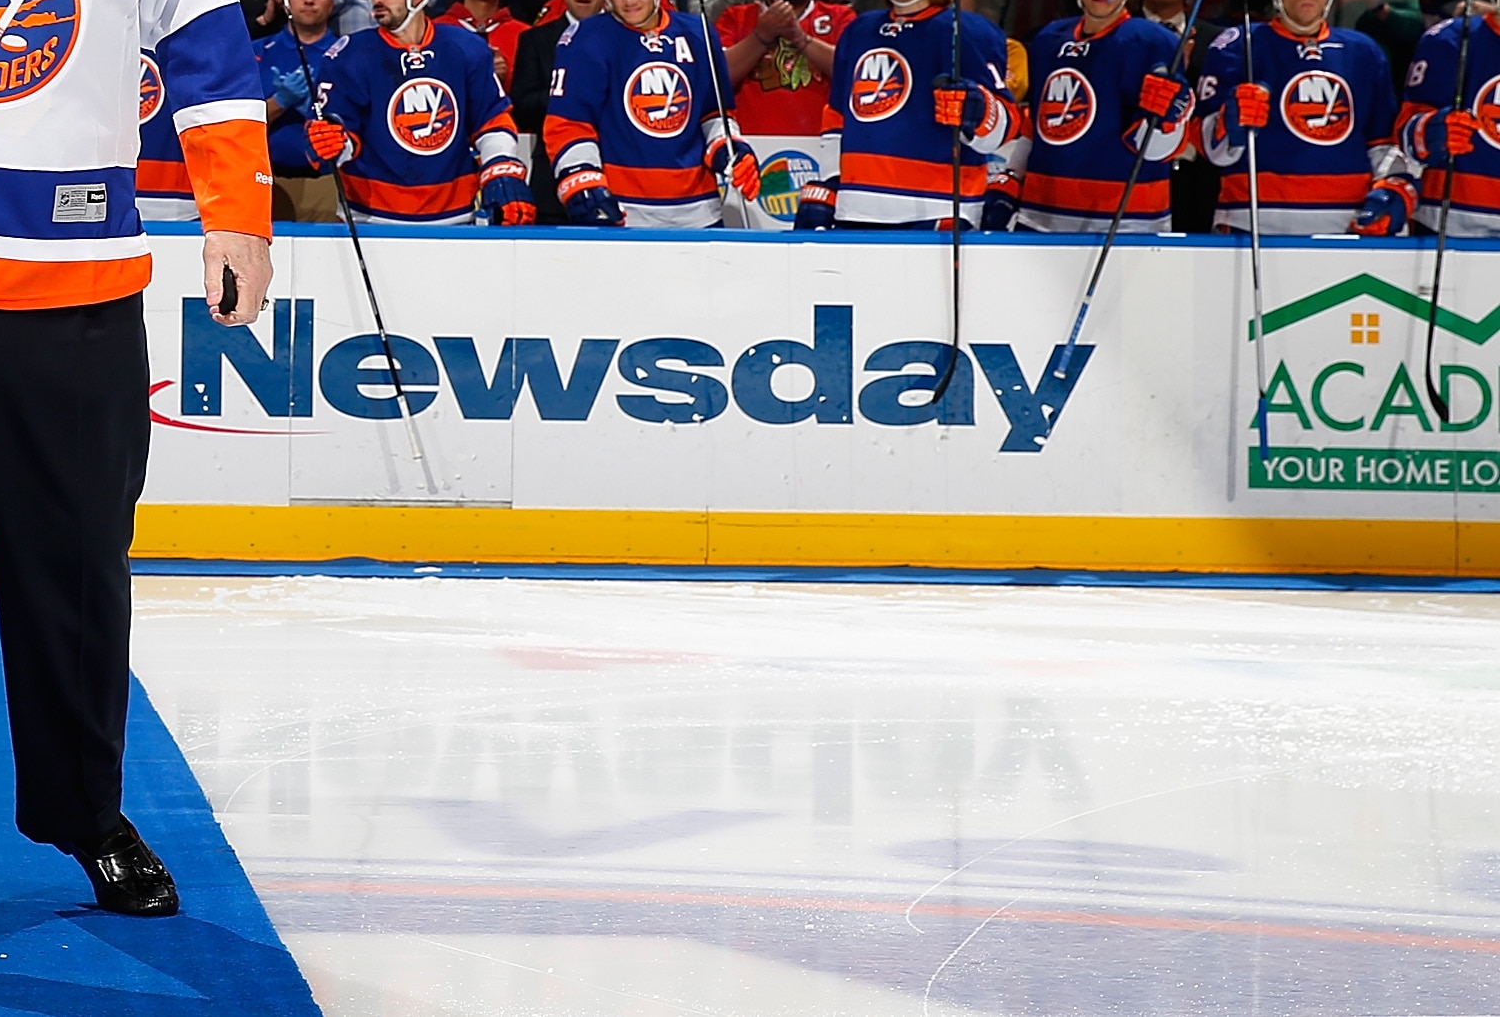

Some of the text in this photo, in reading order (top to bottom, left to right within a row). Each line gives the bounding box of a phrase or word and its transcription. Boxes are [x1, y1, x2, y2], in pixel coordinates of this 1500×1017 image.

[813, 14, 833, 35] C
[674, 36, 694, 63] A
[860, 54, 900, 81] NY
[640, 68, 679, 95] NY
[1047, 74, 1081, 102] NY
[1299, 76, 1341, 103] NY
[402, 84, 444, 114] NY
[480, 164, 524, 183] CCM
[787, 157, 813, 172] NEW
[181, 296, 1097, 453] Newsday
[1248, 359, 1500, 433] ACAD
[1263, 457, 1346, 484] YOUR
[1356, 456, 1450, 485] HOME
